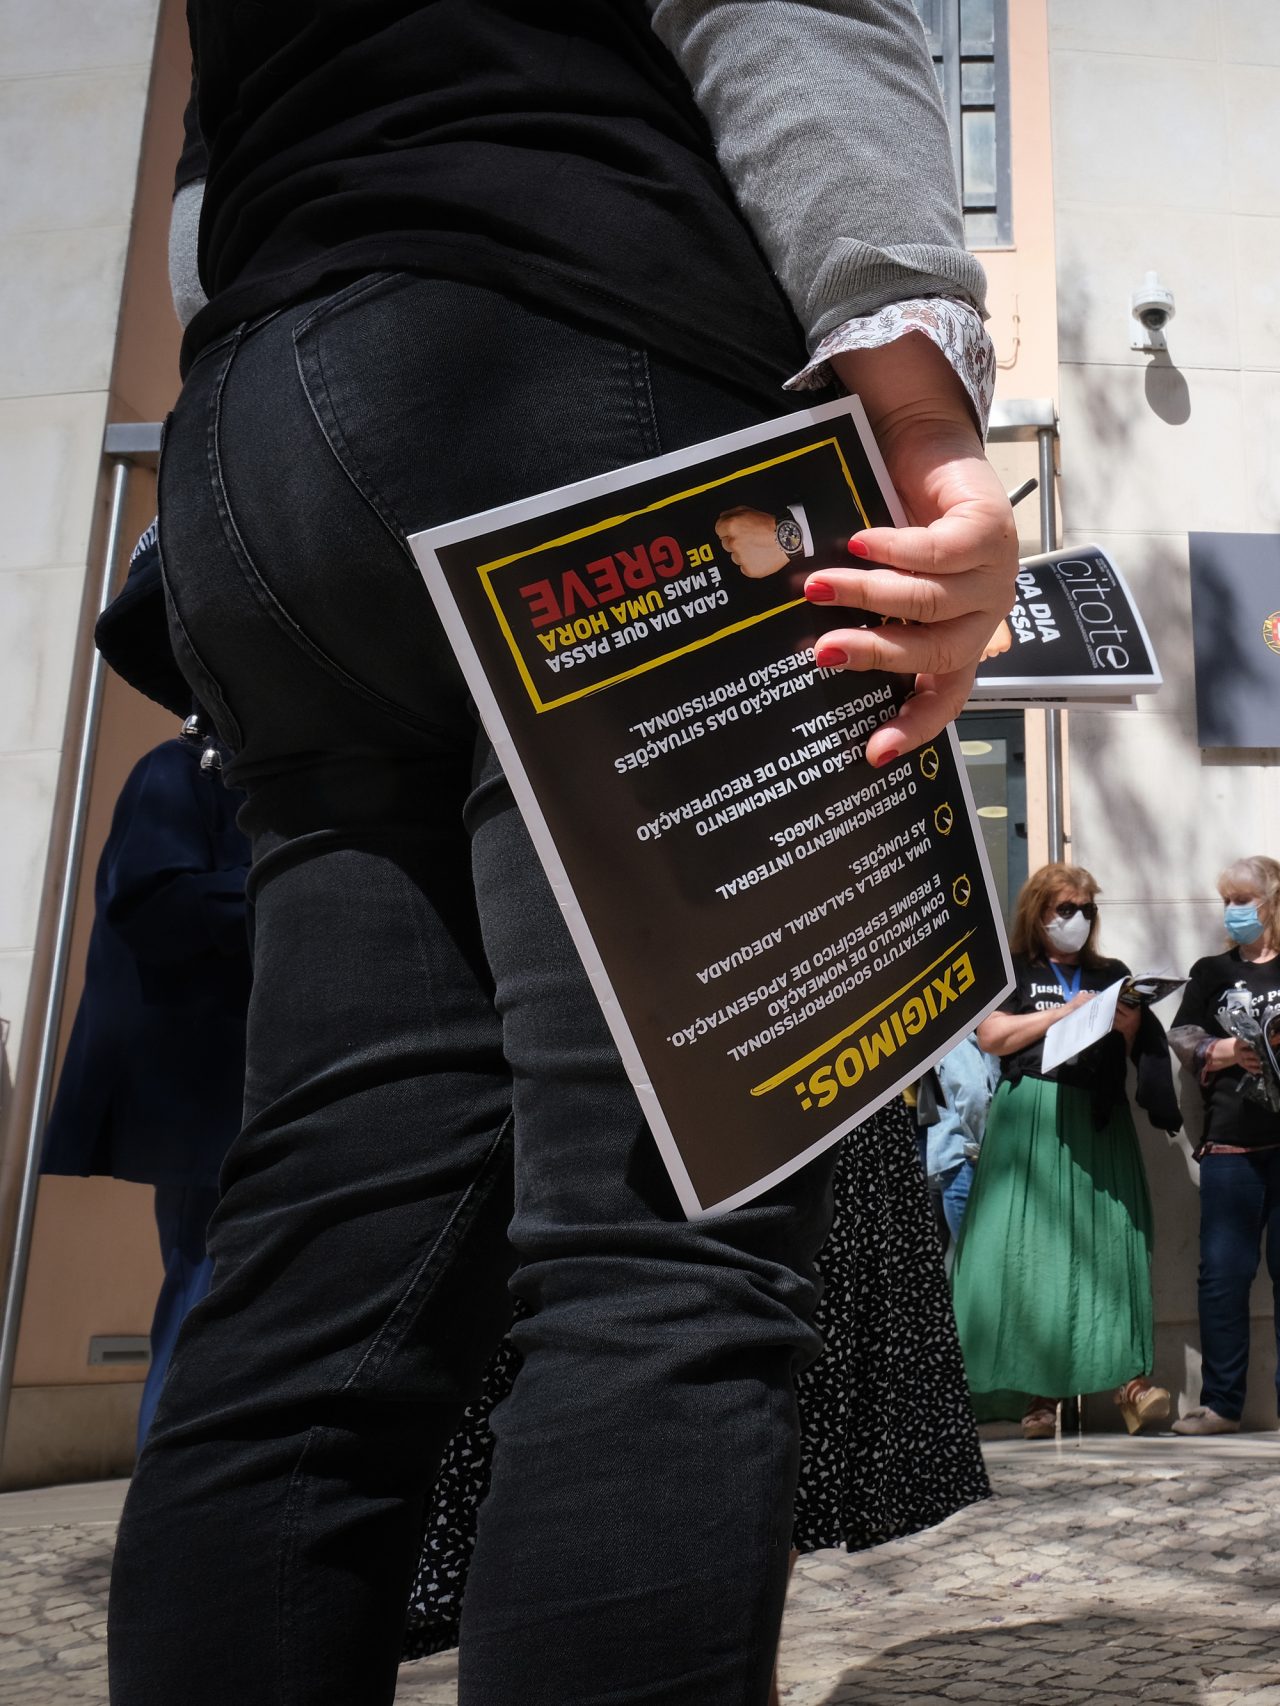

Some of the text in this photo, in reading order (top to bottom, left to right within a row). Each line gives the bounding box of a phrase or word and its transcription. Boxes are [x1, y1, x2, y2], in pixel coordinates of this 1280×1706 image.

[520, 536, 714, 628] DE GREVE
[537, 567, 721, 652] É MAIS UMA HORA
[1029, 604, 1060, 642] DIA
[545, 590, 728, 672] CADA DIA QUE PASSA
[629, 647, 817, 737] GRESSÃO PROFISSIONAL.
[706, 706, 739, 730] DAS
[792, 685, 891, 737] PROCESSUAL.
[615, 722, 704, 773] SITUAÇÕES
[637, 705, 902, 840] DO SUPLEMENTO DE RECUPERAÇÃO
[696, 741, 867, 835] USÃO NO VENCIMENTO
[716, 782, 916, 899] O PREENCHIMENTO INTEGRAL
[770, 763, 912, 847] DOS LUGARES VAGOS.
[849, 819, 926, 874] ÀS FUNÇÕES.
[696, 838, 931, 984] UMA TABELA SALARIAL ADEQUADA
[768, 892, 944, 1016] COM VÍNCULO DE NOMEAÇÃO
[667, 874, 940, 1046] E REGIME ESPECÍFICO DE APOSENTAÇÃO.
[727, 910, 949, 1061] UM ESTATUTO SOCIOPROFISSIONAL
[795, 952, 975, 1110] EXIGIMOS:
